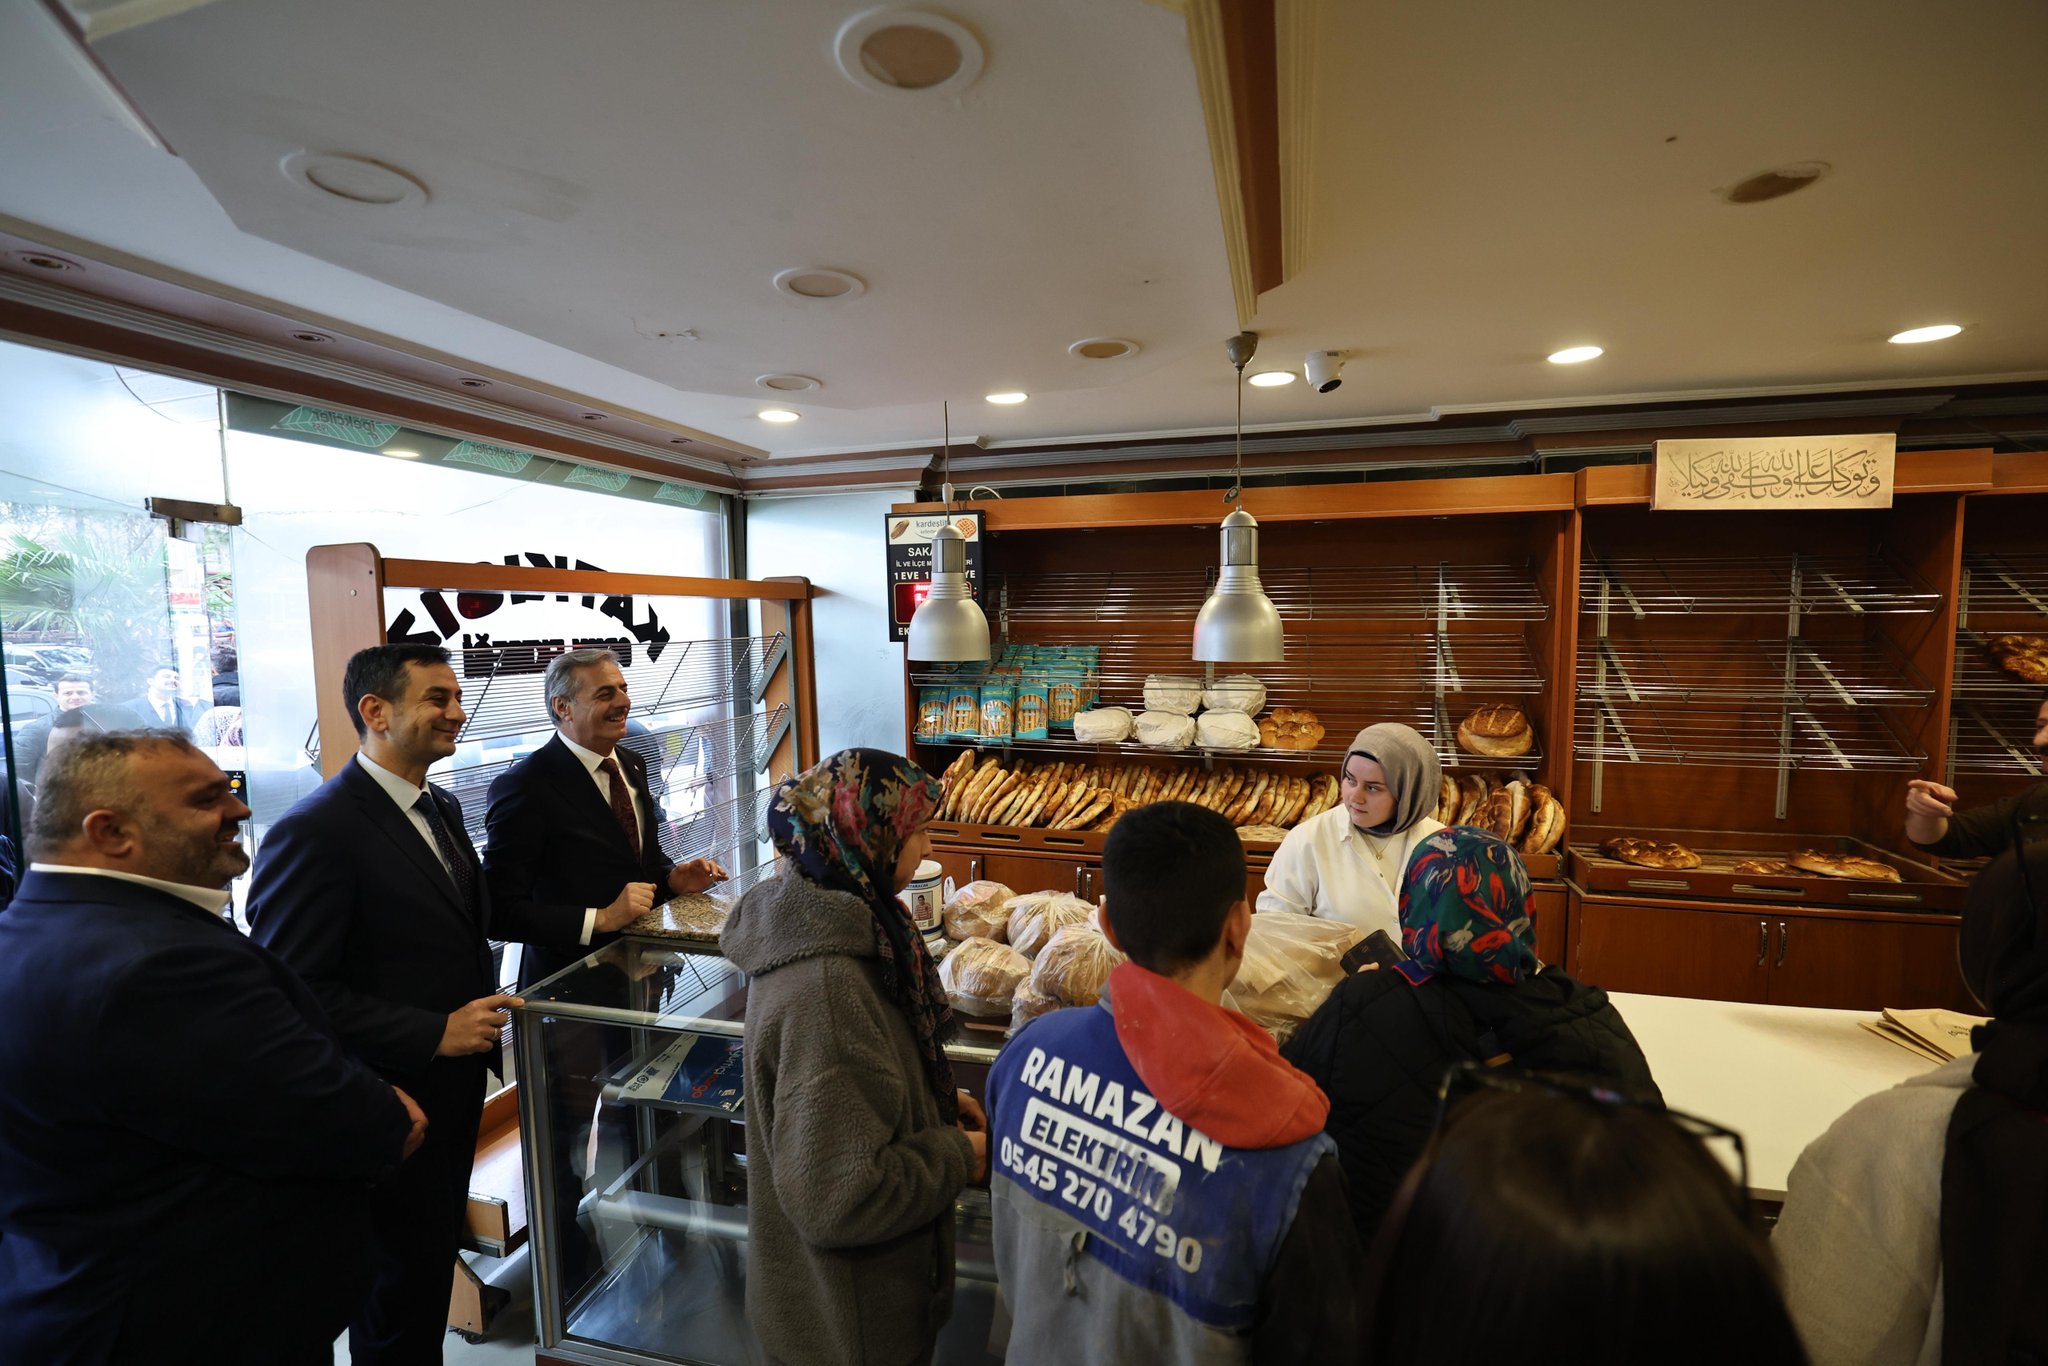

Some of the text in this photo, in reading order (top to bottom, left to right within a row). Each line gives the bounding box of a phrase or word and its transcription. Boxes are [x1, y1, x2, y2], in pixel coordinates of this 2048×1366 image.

[901, 571, 919, 580] EVE
[1020, 1047, 1224, 1173] RAMAZAN
[1001, 1136, 1202, 1273] 0545 270 4790
